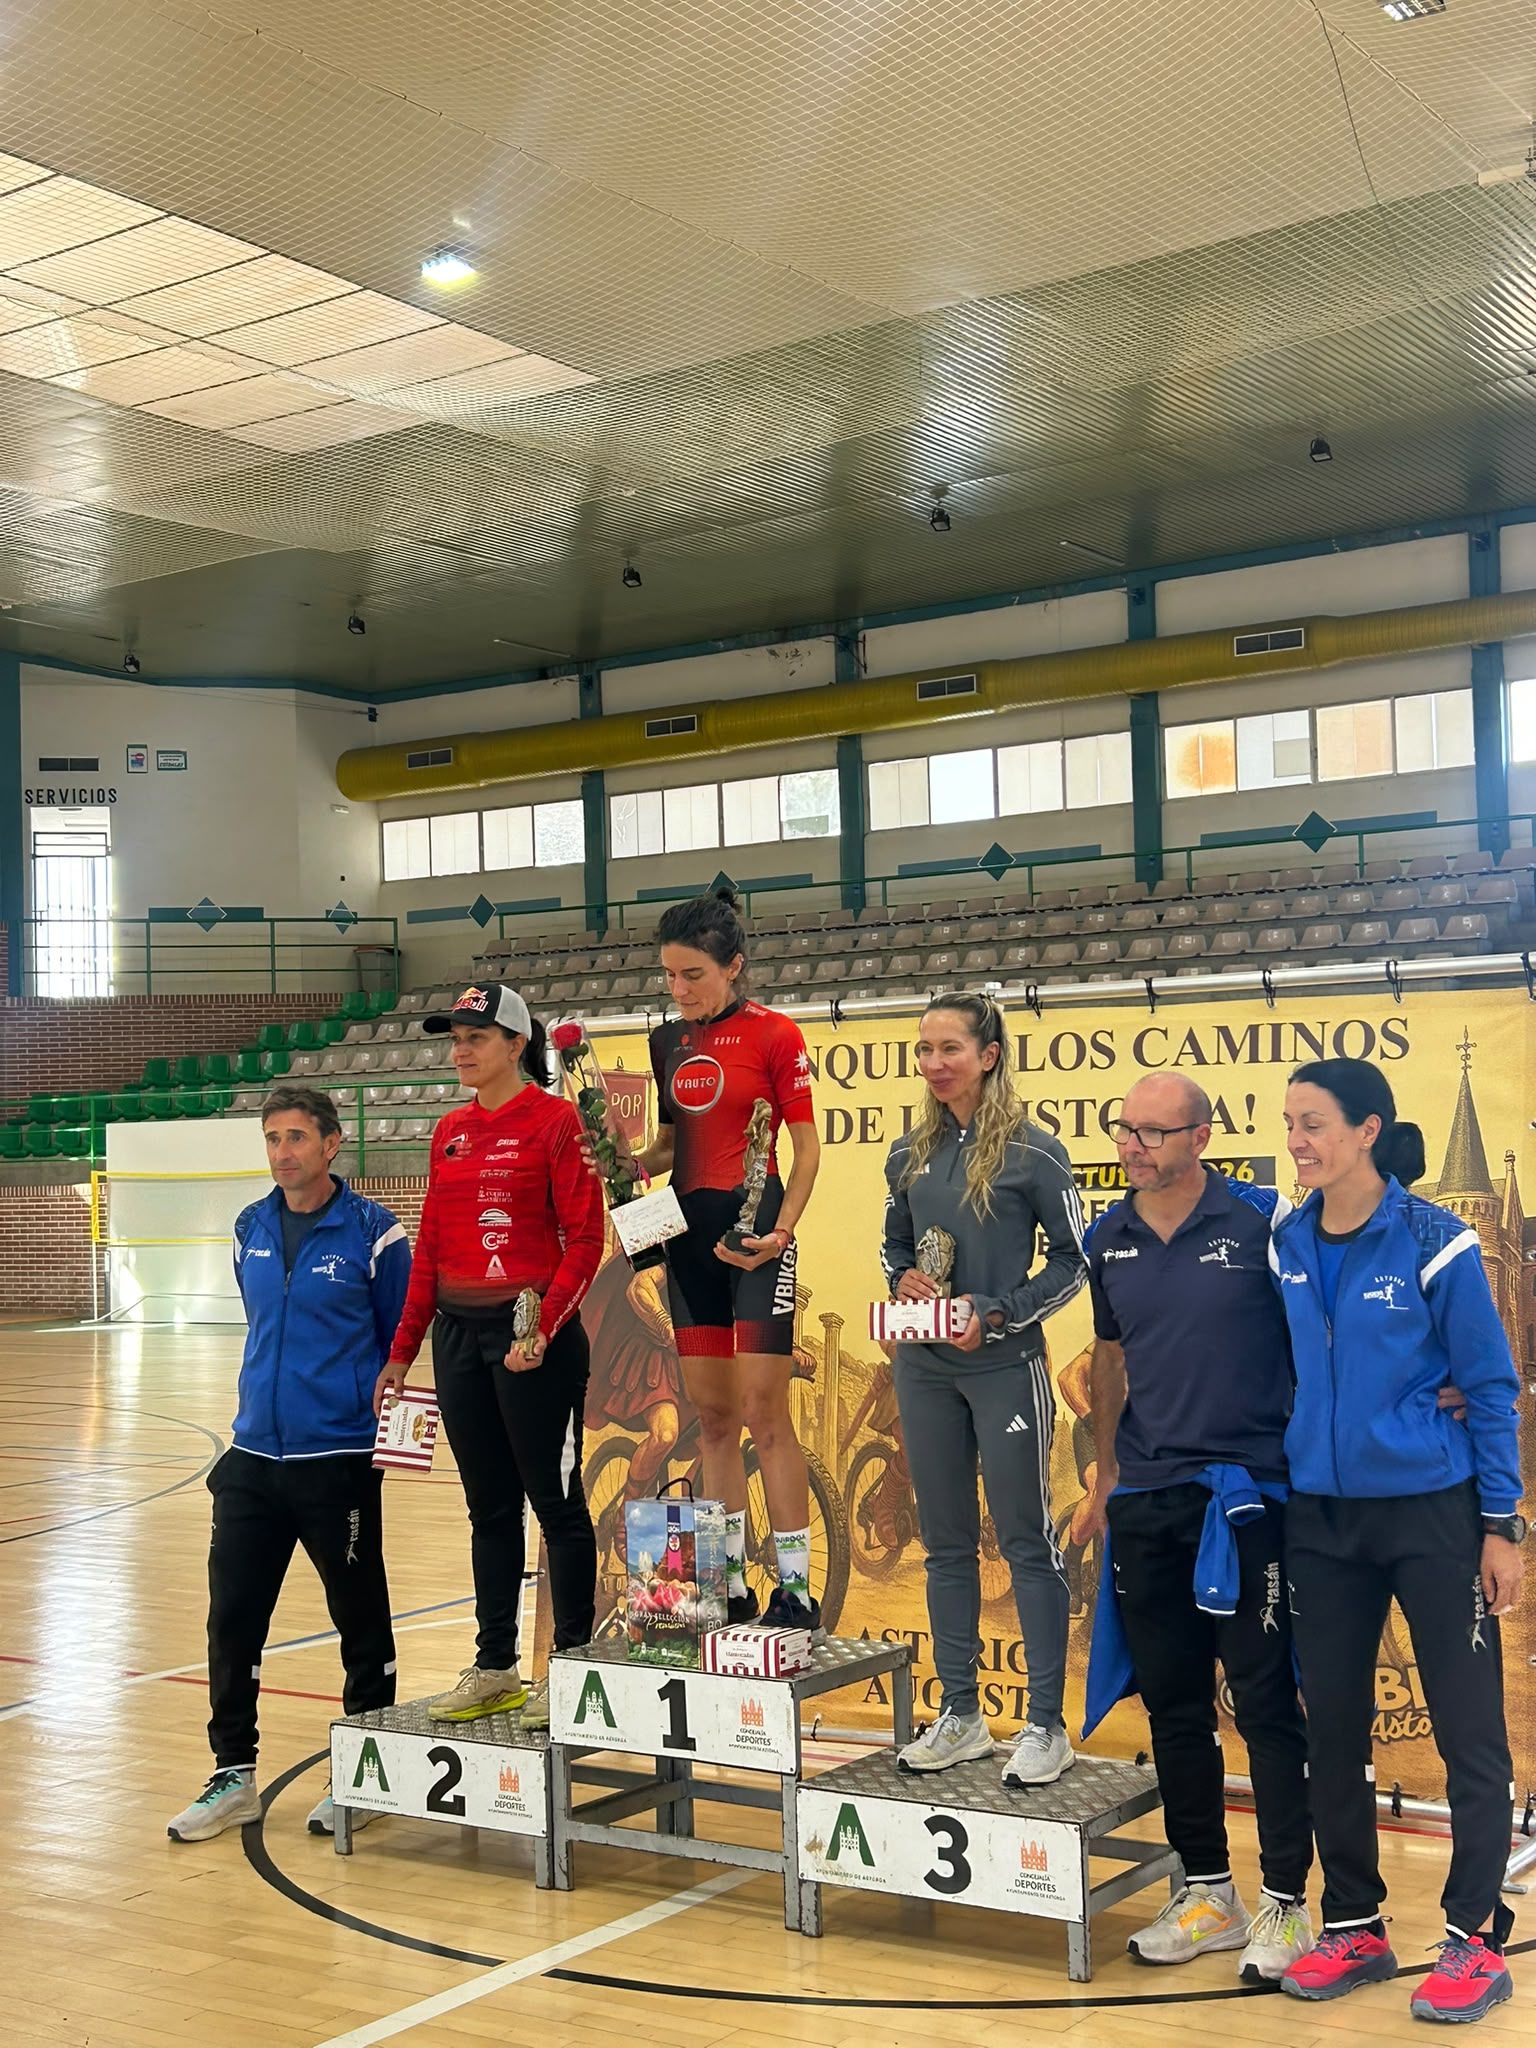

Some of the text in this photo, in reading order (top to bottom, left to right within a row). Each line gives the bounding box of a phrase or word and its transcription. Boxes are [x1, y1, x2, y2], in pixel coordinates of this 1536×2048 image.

[24, 787, 118, 805] SERVICIOS
[1014, 1030, 1116, 1073] LOS
[1132, 1017, 1411, 1068] CAMINOS
[676, 1077, 716, 1090] VAUTO
[823, 1105, 885, 1146] DE
[1263, 1562, 1280, 1604] rasán
[657, 1679, 697, 1751] 1
[1370, 1711, 1433, 1742] Asto
[735, 1735, 772, 1746] DEPORTES
[426, 1745, 466, 1817] 2
[494, 1800, 526, 1811] DEPORTES
[923, 1814, 972, 1895] 3
[1014, 1879, 1057, 1893] DEPORTES
